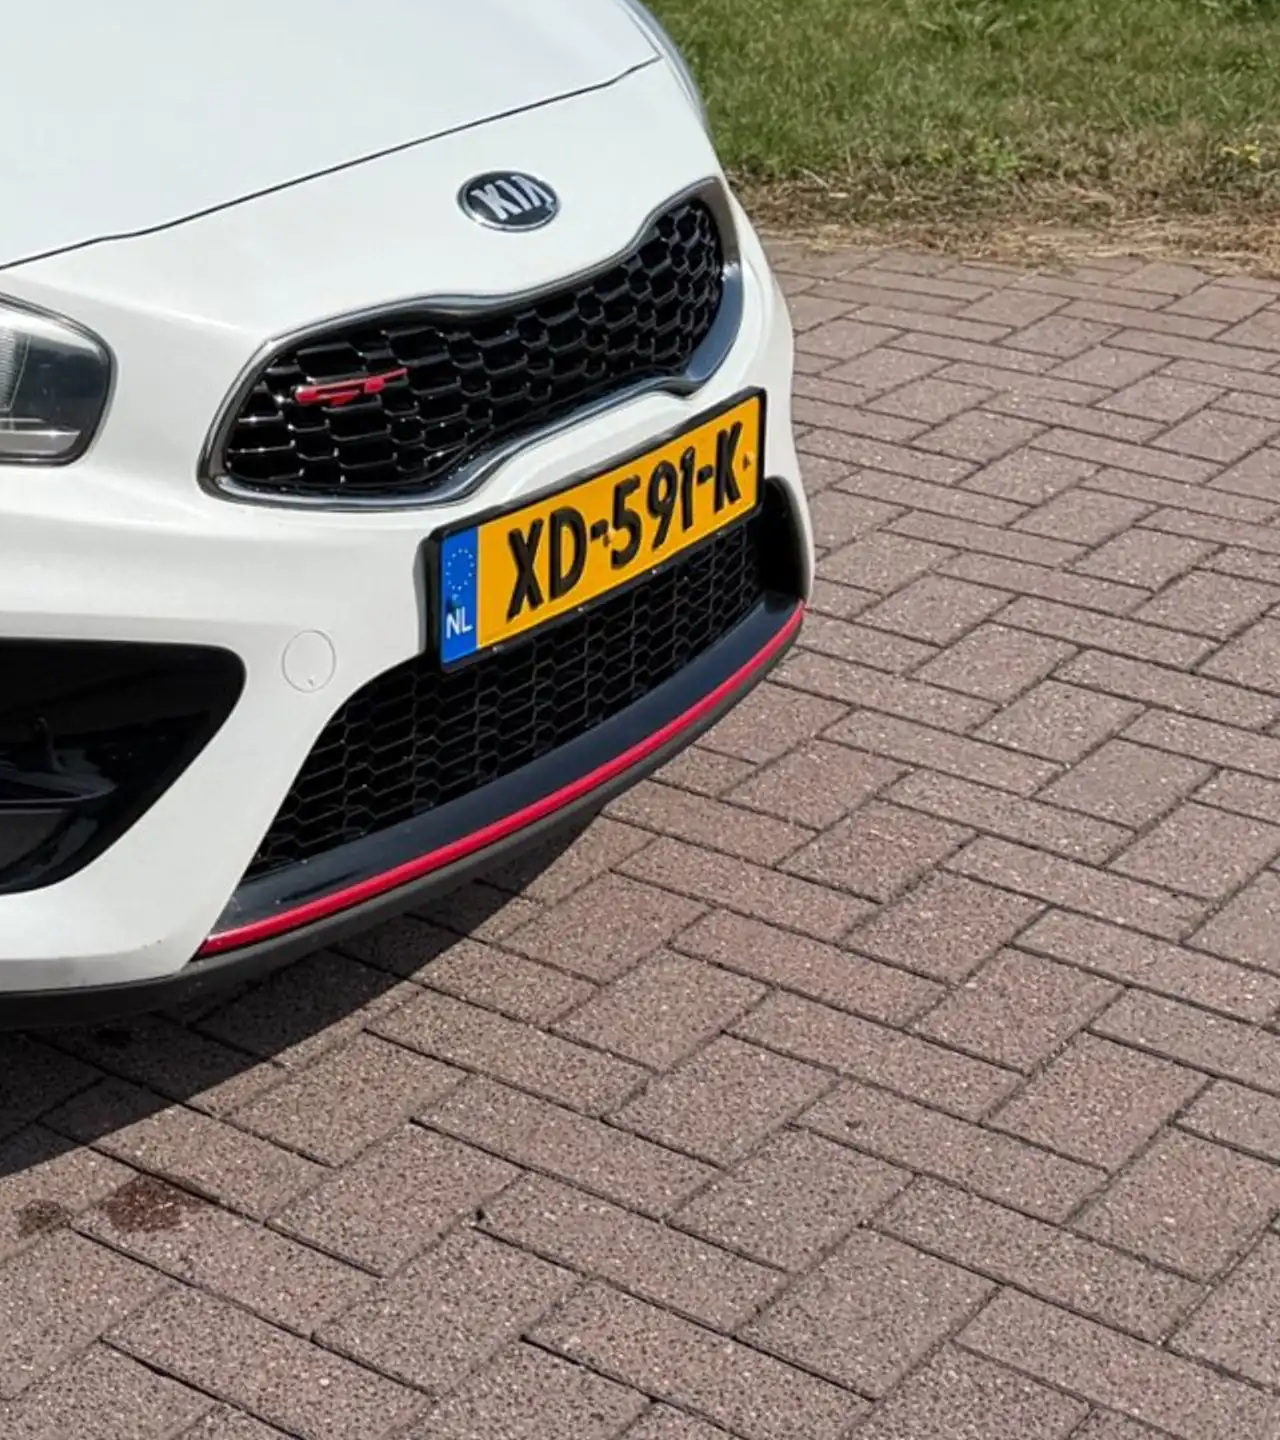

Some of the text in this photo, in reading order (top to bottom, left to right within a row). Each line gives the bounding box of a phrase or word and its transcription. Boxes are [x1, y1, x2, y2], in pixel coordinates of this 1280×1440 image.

[469, 174, 554, 221] KIA
[506, 420, 743, 623] XD-591-K
[445, 605, 474, 640] NL
